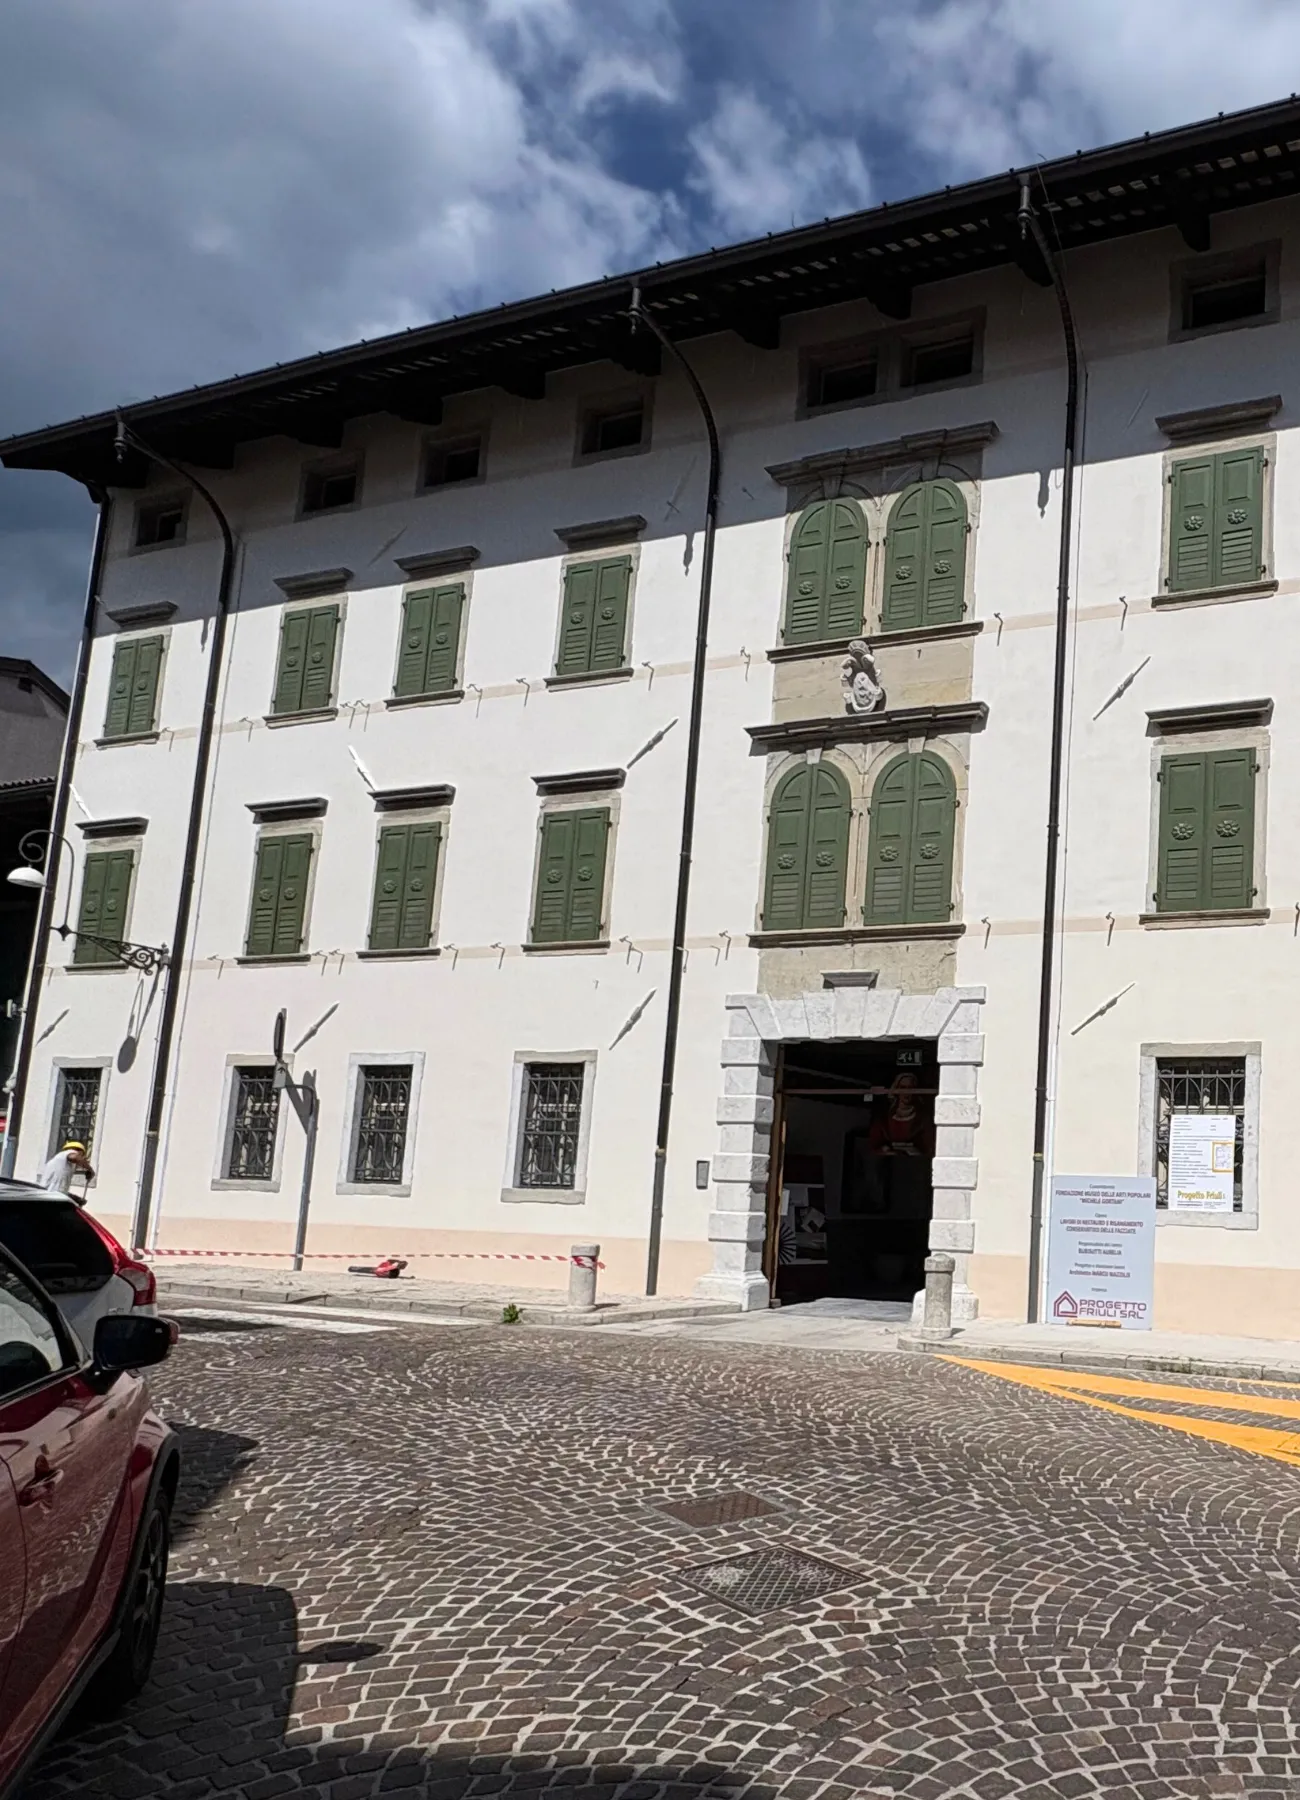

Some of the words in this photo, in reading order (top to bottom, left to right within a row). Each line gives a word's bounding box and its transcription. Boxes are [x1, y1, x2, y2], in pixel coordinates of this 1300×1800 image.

[1177, 1190, 1205, 1201] Progetto
[1206, 1190, 1223, 1199] Friuli
[1080, 1299, 1147, 1311] PROGETTO
[1080, 1307, 1116, 1317] FRIULI
[1120, 1310, 1144, 1319] SRL
